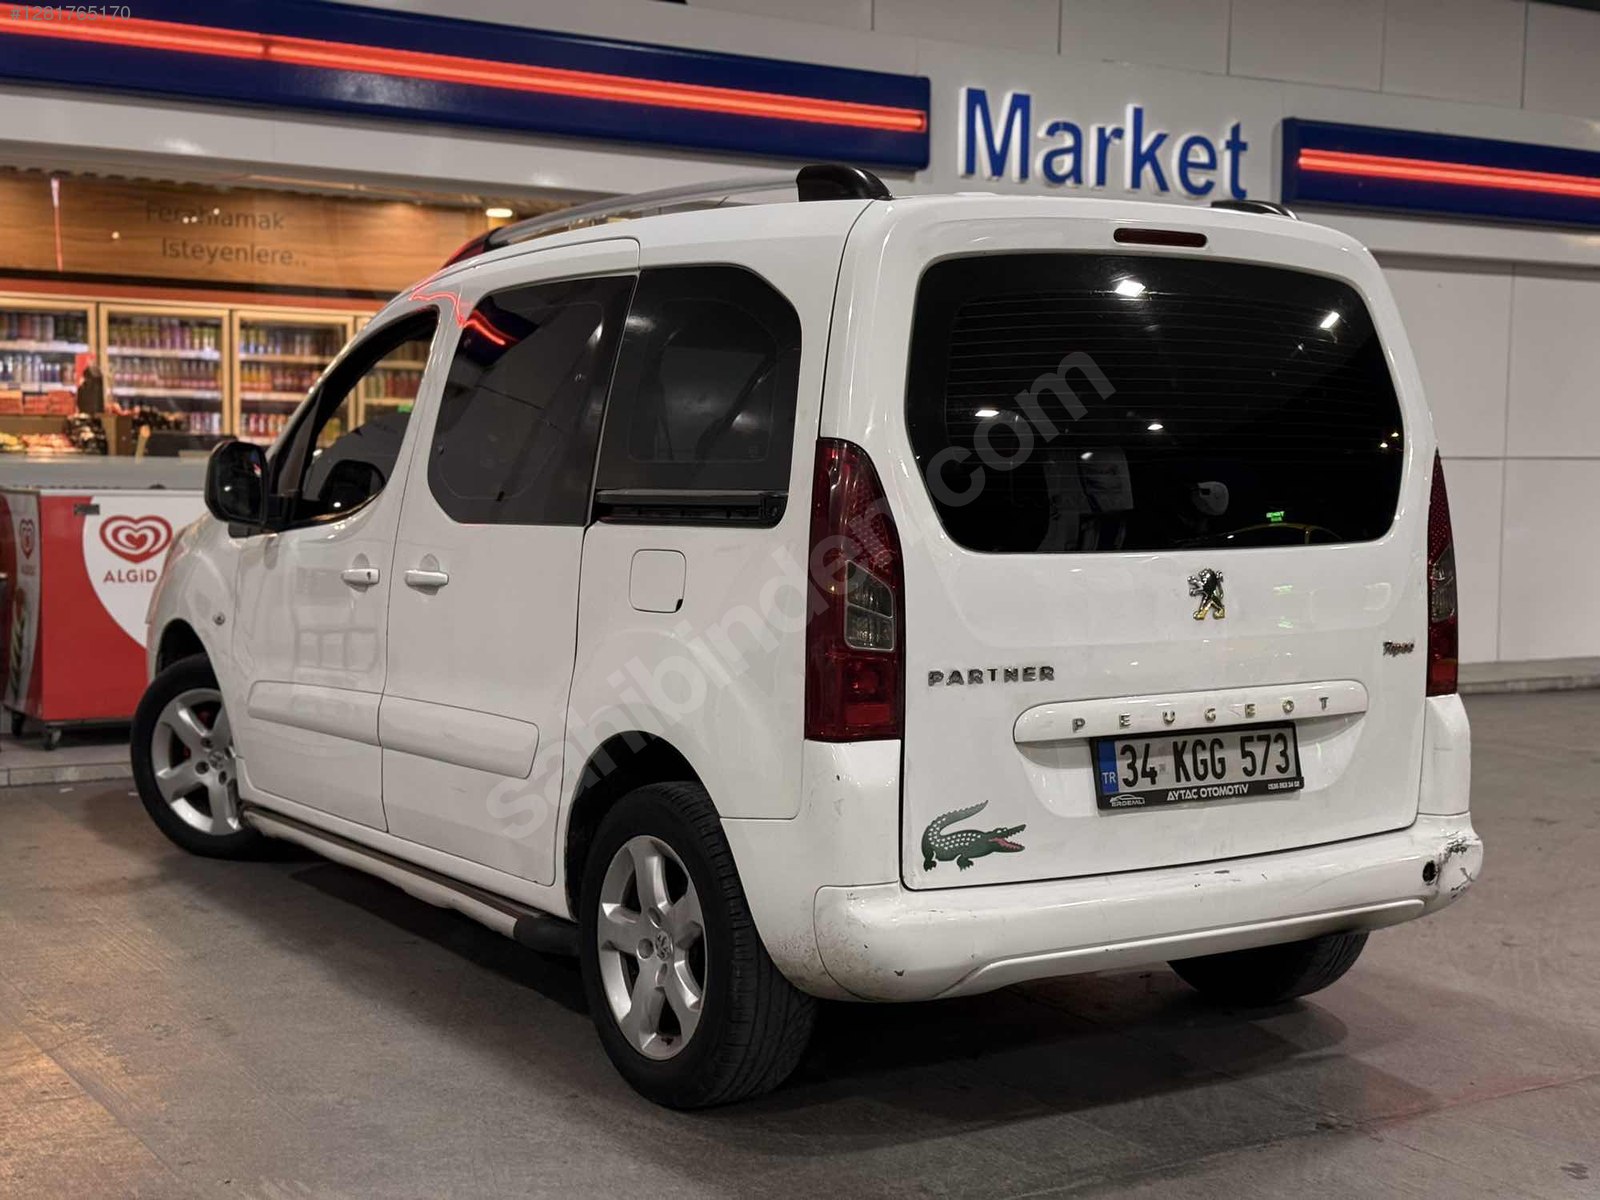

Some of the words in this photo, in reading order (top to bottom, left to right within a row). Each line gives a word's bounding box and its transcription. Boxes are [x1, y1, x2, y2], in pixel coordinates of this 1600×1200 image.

[960, 87, 1248, 200] Market
[103, 569, 158, 583] ALGID
[928, 666, 1055, 686] PARTNER
[1072, 697, 1329, 732] PEUGEOT
[1120, 743, 1157, 787] 34
[1172, 738, 1226, 783] KGG
[1240, 733, 1290, 777] 573
[1102, 772, 1116, 784] TR
[1167, 789, 1198, 800] AYTAÇ
